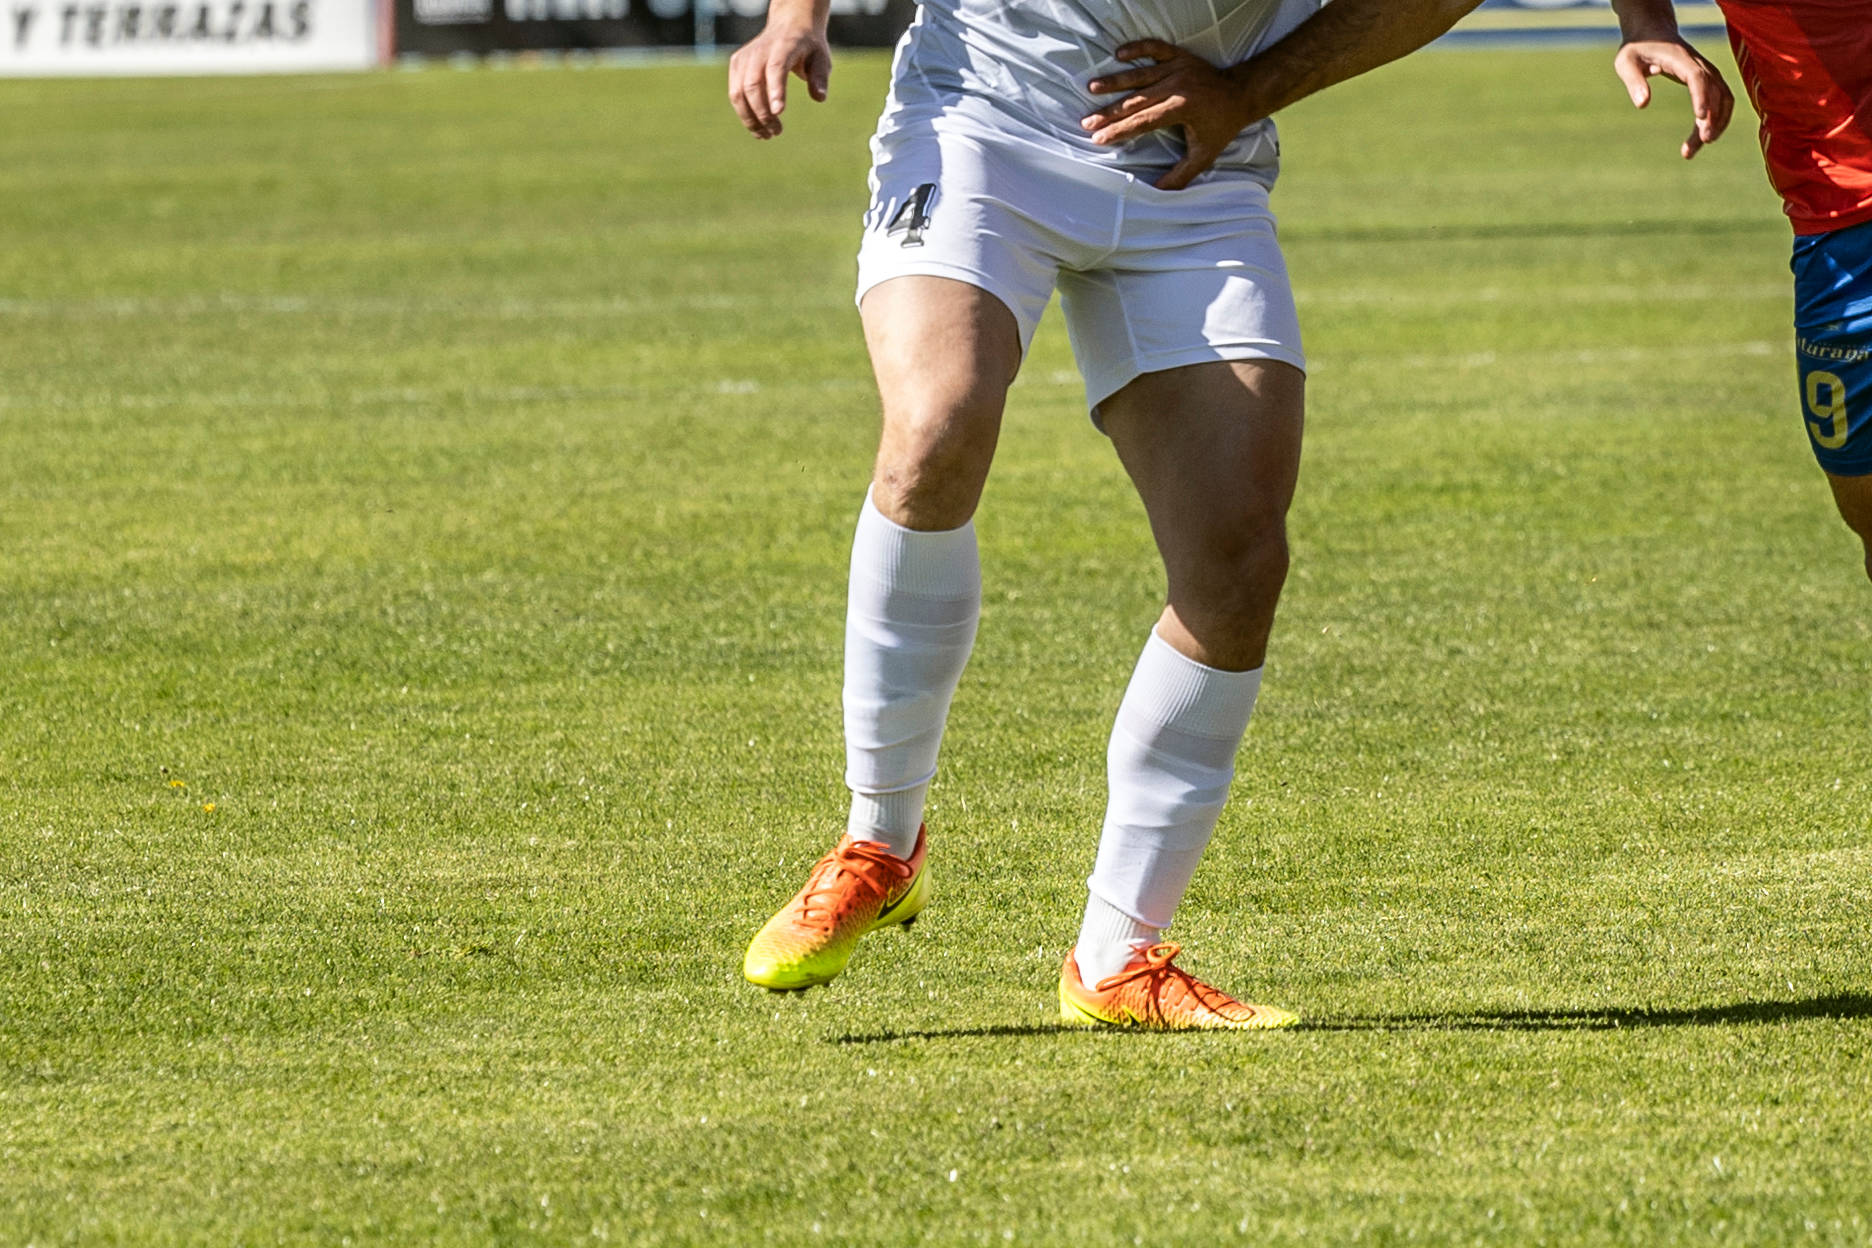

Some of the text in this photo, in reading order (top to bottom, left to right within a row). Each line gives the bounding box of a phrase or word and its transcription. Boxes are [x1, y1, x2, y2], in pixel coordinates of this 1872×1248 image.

[13, 4, 38, 48] Y
[886, 182, 936, 249] 4
[1806, 370, 1848, 450] 9
